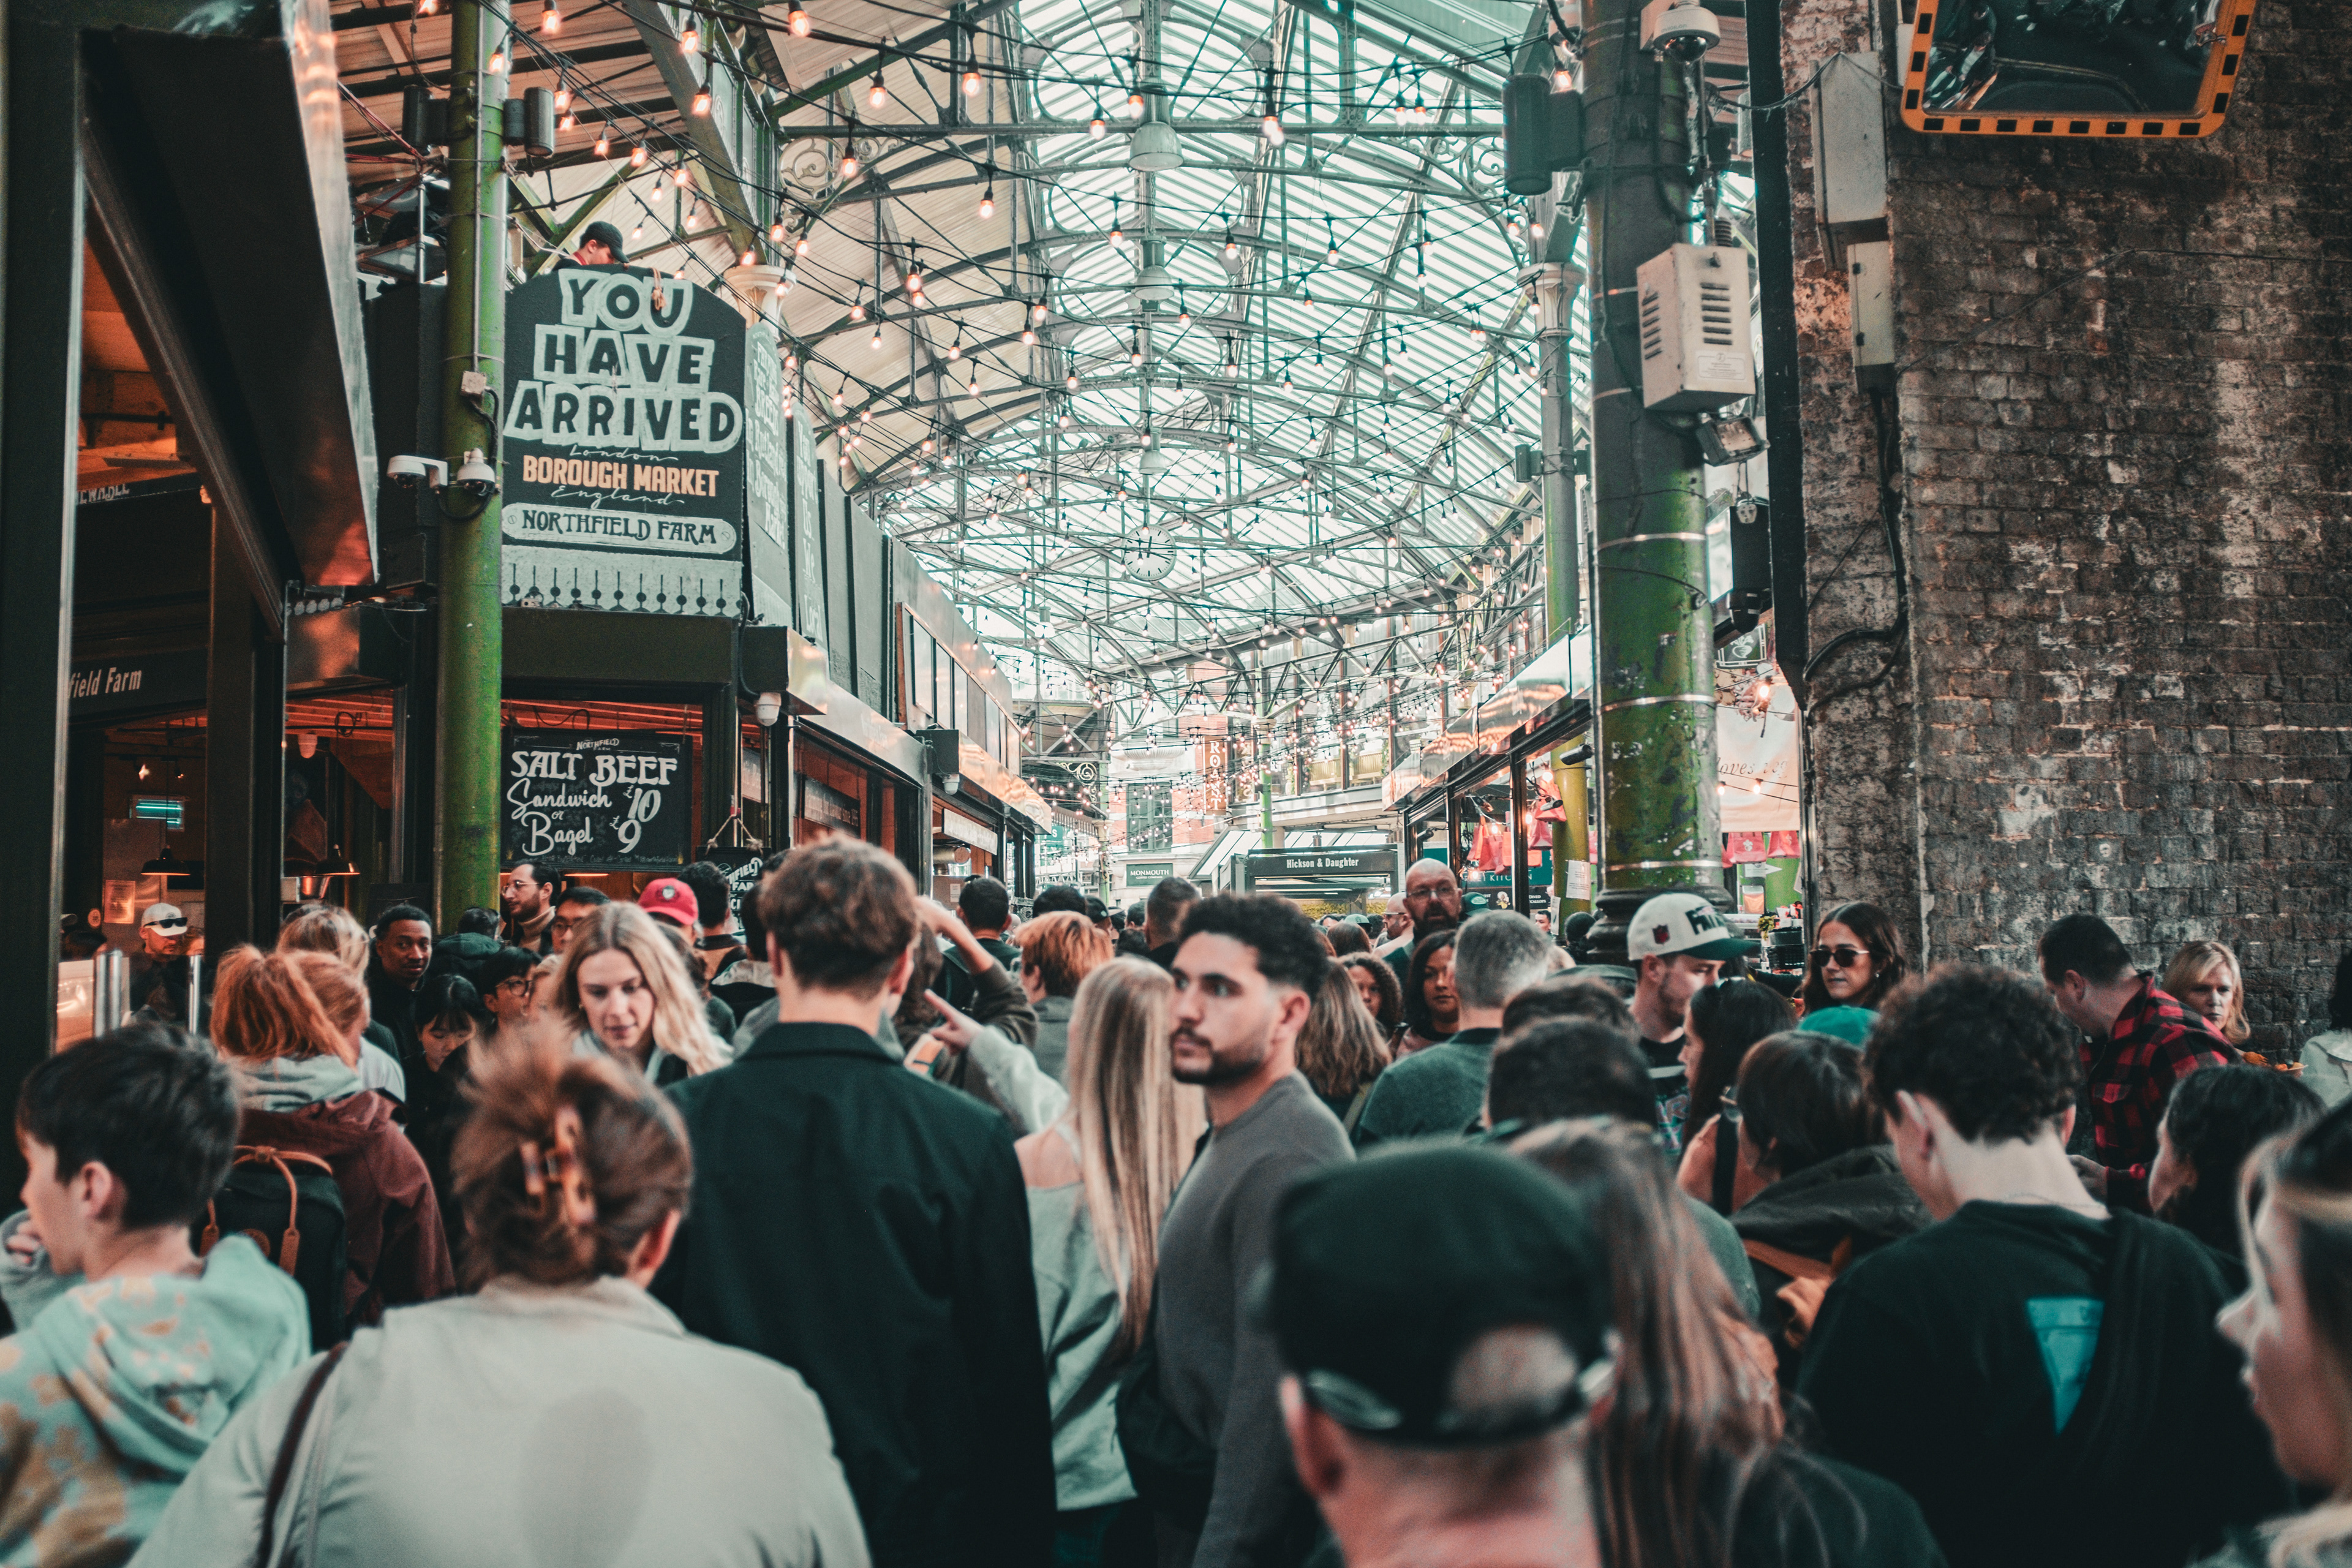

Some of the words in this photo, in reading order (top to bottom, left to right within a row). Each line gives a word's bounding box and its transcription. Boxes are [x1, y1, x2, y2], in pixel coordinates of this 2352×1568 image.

[562, 271, 690, 334] YOU
[537, 326, 712, 389] HAVE
[507, 383, 740, 450] ARRIVED
[570, 444, 679, 462] London
[522, 454, 628, 489] BOROUGH
[633, 464, 719, 497] MARKET
[551, 485, 685, 509] England
[522, 509, 651, 541] NORTHFIELD
[657, 521, 717, 546] FARM
[105, 666, 142, 694] Farm
[576, 737, 620, 751] NORTHFIELD
[511, 750, 584, 780] SALT
[589, 754, 677, 787] BEEF
[507, 777, 612, 820] Sandwich
[551, 809, 564, 821] or
[521, 810, 594, 856] Bagel
[1286, 859, 1314, 869] Hickson
[1317, 858, 1323, 868] &
[1325, 857, 1359, 869] Daughter
